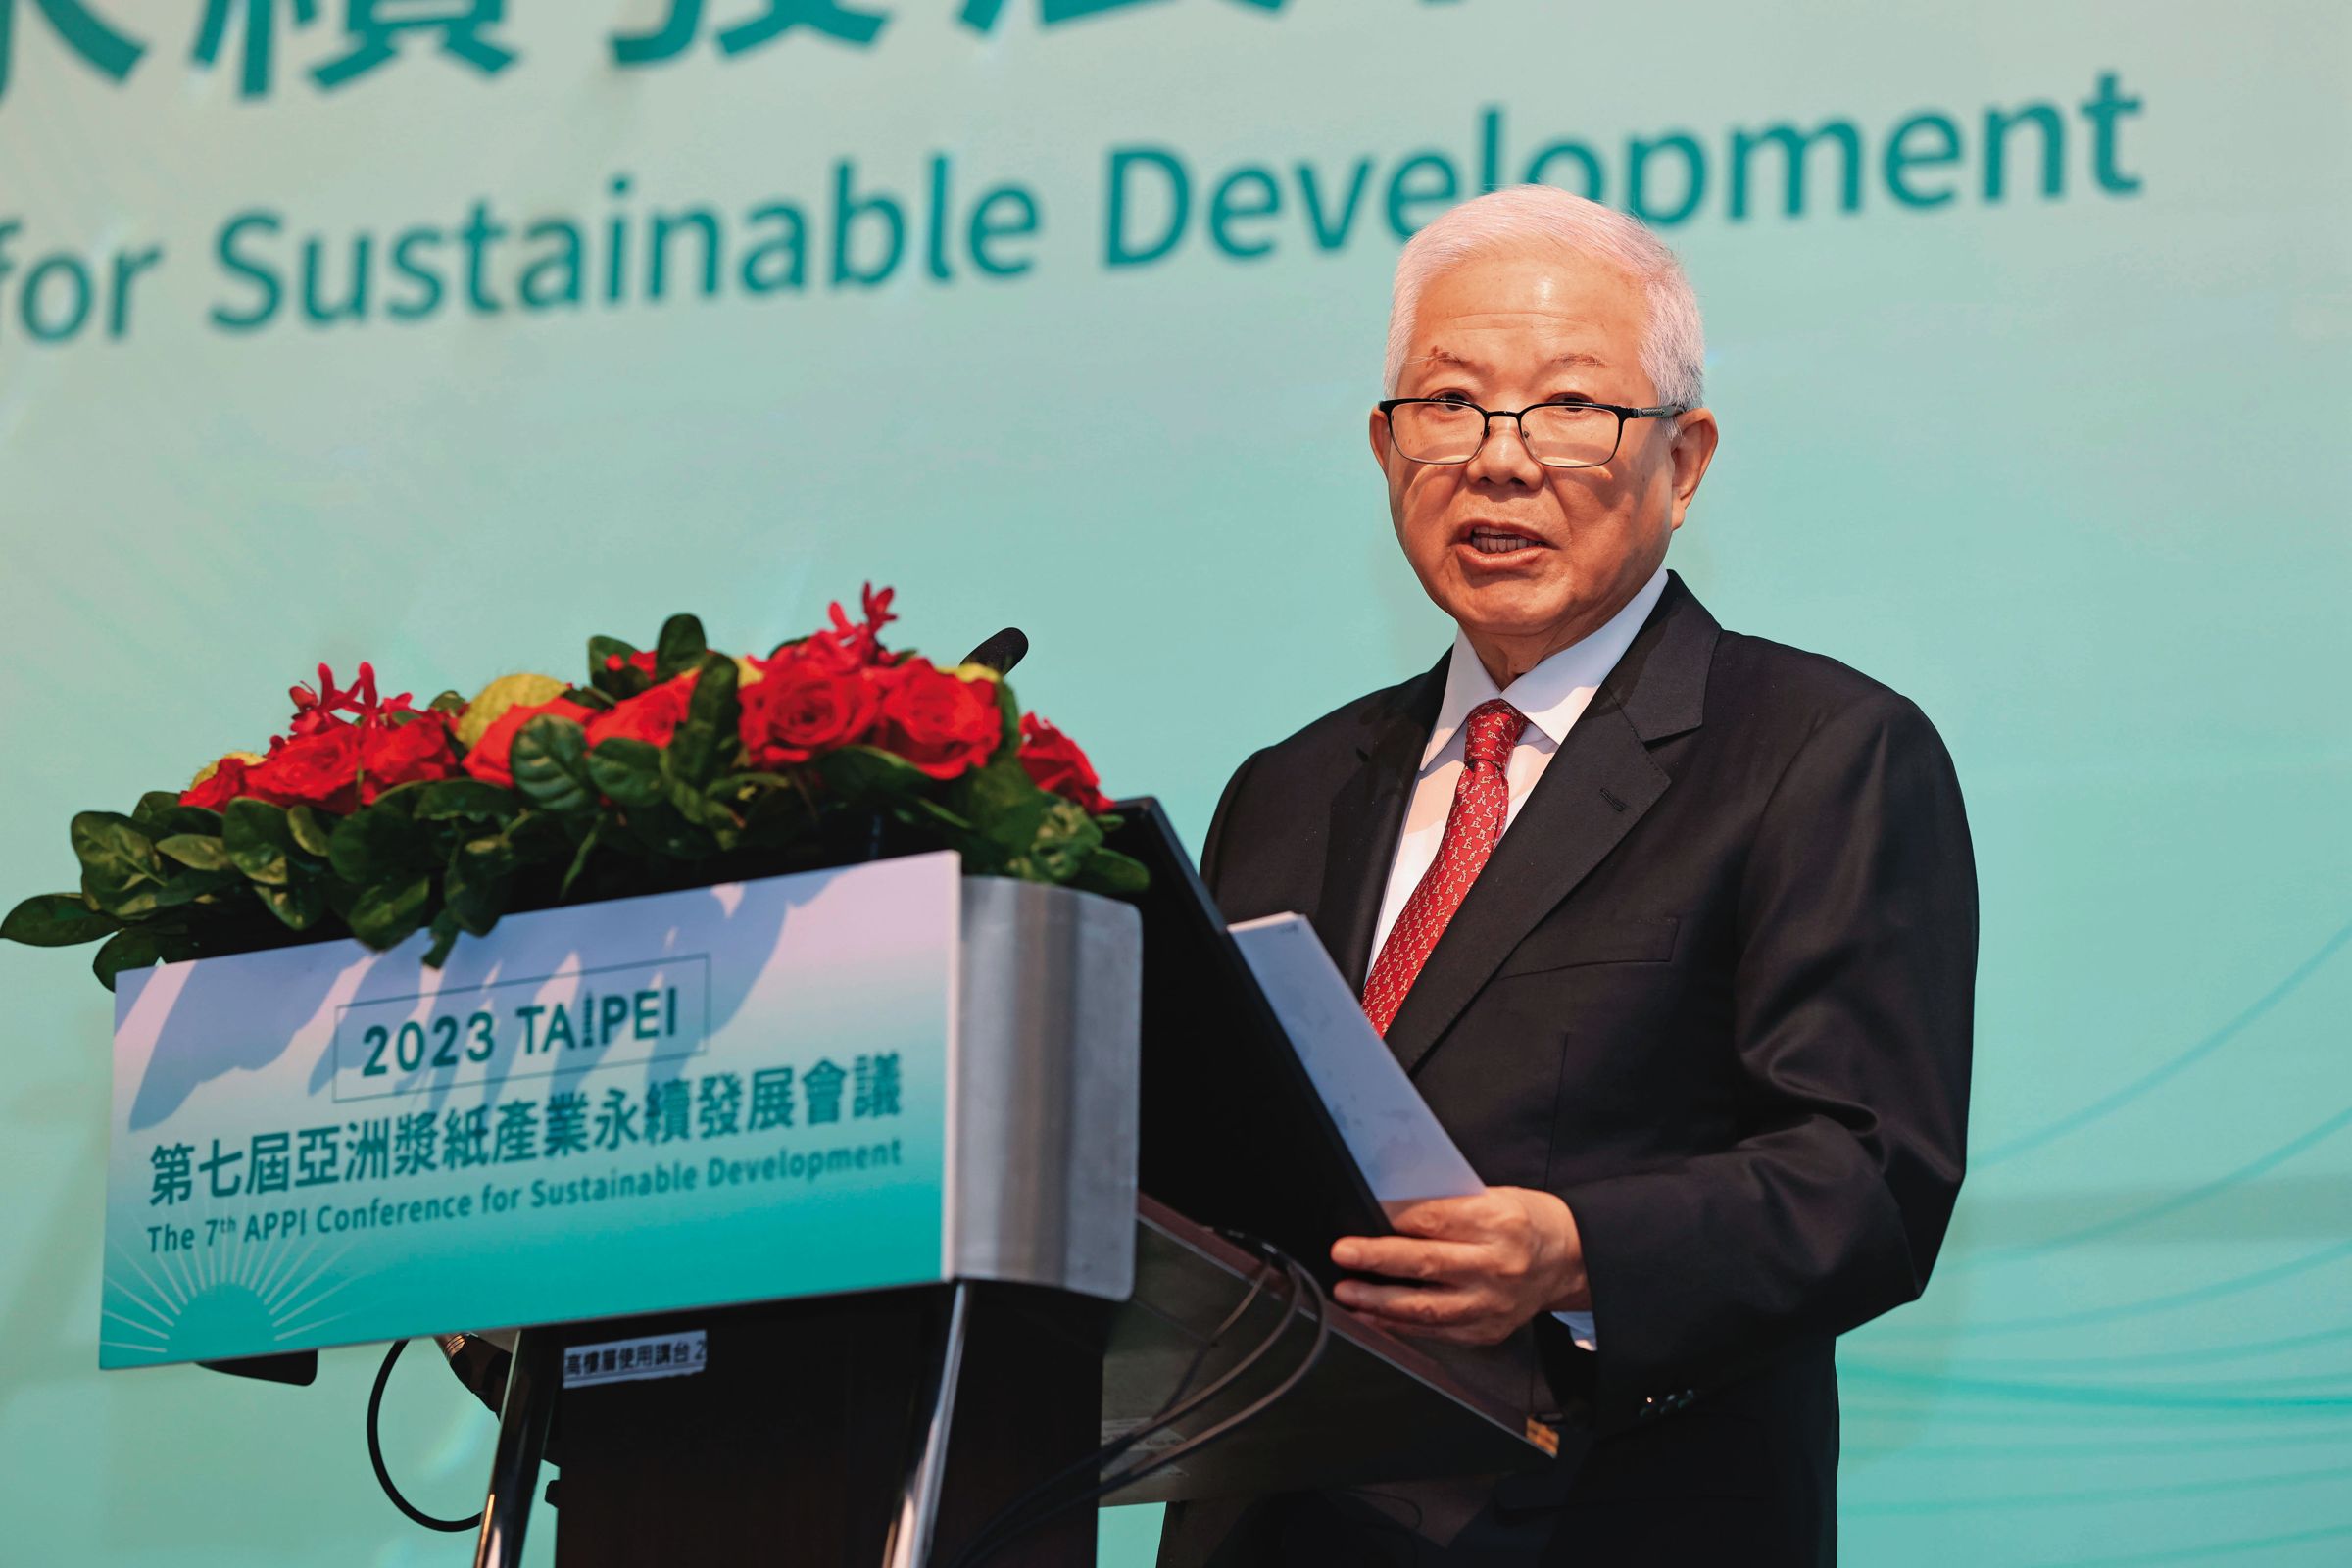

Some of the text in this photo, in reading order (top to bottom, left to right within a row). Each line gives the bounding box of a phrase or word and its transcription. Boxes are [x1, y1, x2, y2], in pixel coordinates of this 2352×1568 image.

[208, 151, 1042, 333] Sustainable
[362, 986, 678, 1077] 2023 TAIPEI
[147, 1138, 902, 1253] The 7th APPI Conference for Sustainable Development
[149, 1051, 902, 1207] 第七屆亞洲漿紙產業永續發展會議
